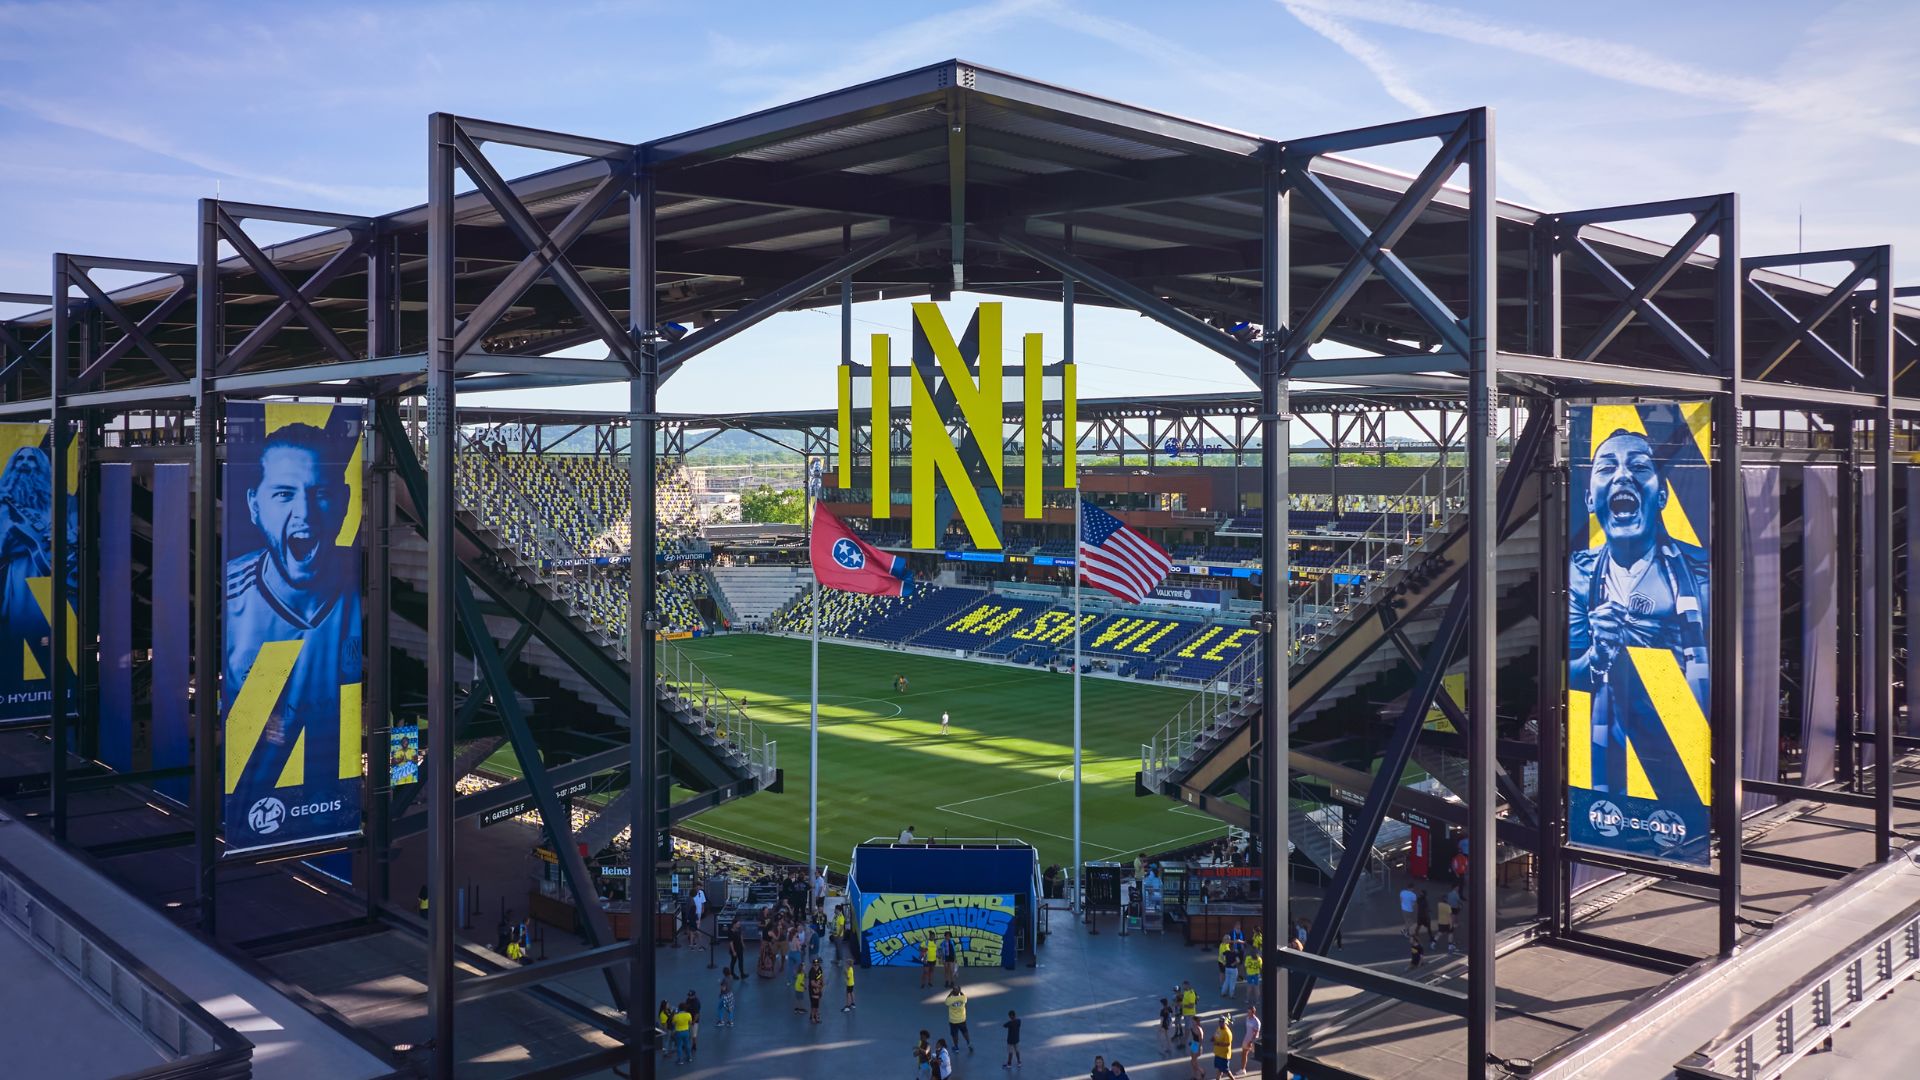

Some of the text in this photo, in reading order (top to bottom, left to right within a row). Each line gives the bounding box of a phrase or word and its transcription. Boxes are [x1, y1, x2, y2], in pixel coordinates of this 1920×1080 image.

[1155, 588, 1183, 598] VALKYRIE
[7, 689, 72, 704] HYUNI
[290, 800, 341, 817] GEODIS
[492, 807, 509, 820] GATES
